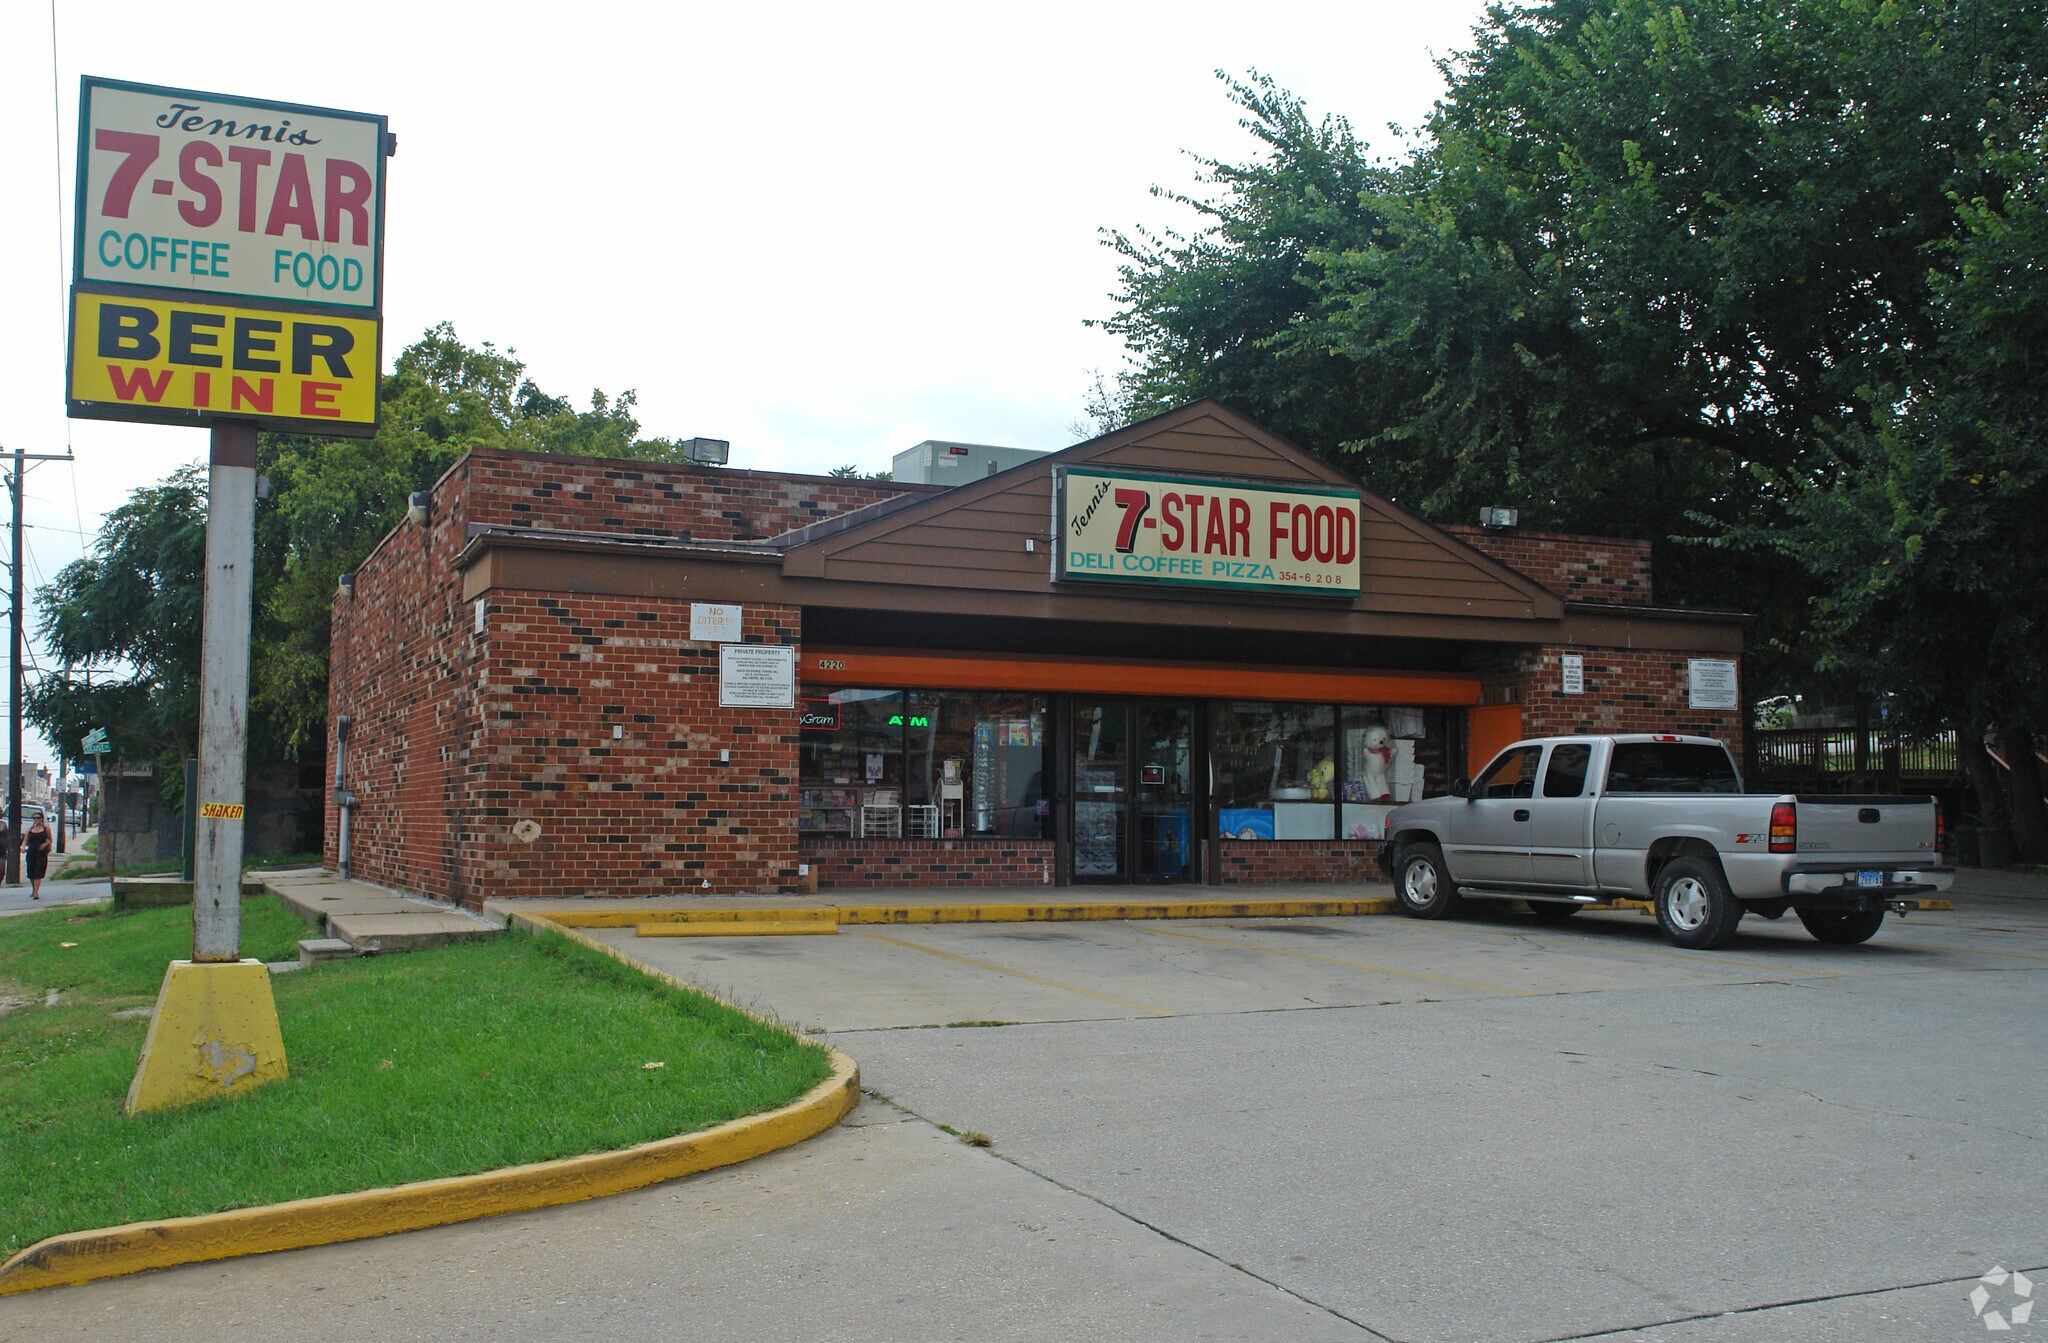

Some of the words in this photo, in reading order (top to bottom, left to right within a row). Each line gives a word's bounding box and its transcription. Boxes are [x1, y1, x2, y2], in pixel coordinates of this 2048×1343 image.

[156, 103, 322, 146] Tennis
[95, 129, 372, 246] 7-STAR
[98, 230, 230, 278] COFFEE
[274, 249, 363, 292] FOOD
[98, 303, 355, 379] BEER
[106, 364, 342, 417] WINE
[1071, 480, 1112, 536] Tennis
[1114, 487, 1250, 557] 7-STAR
[1269, 501, 1356, 564] FOOD
[1070, 551, 1115, 570] DELI
[1122, 554, 1203, 575] COFFEE
[1212, 560, 1275, 580] PIZZA
[709, 607, 723, 615] NO
[820, 660, 844, 669] 4220
[889, 715, 928, 727] AM
[202, 803, 243, 819] SHAKEN
[1736, 834, 1765, 844] Z71
